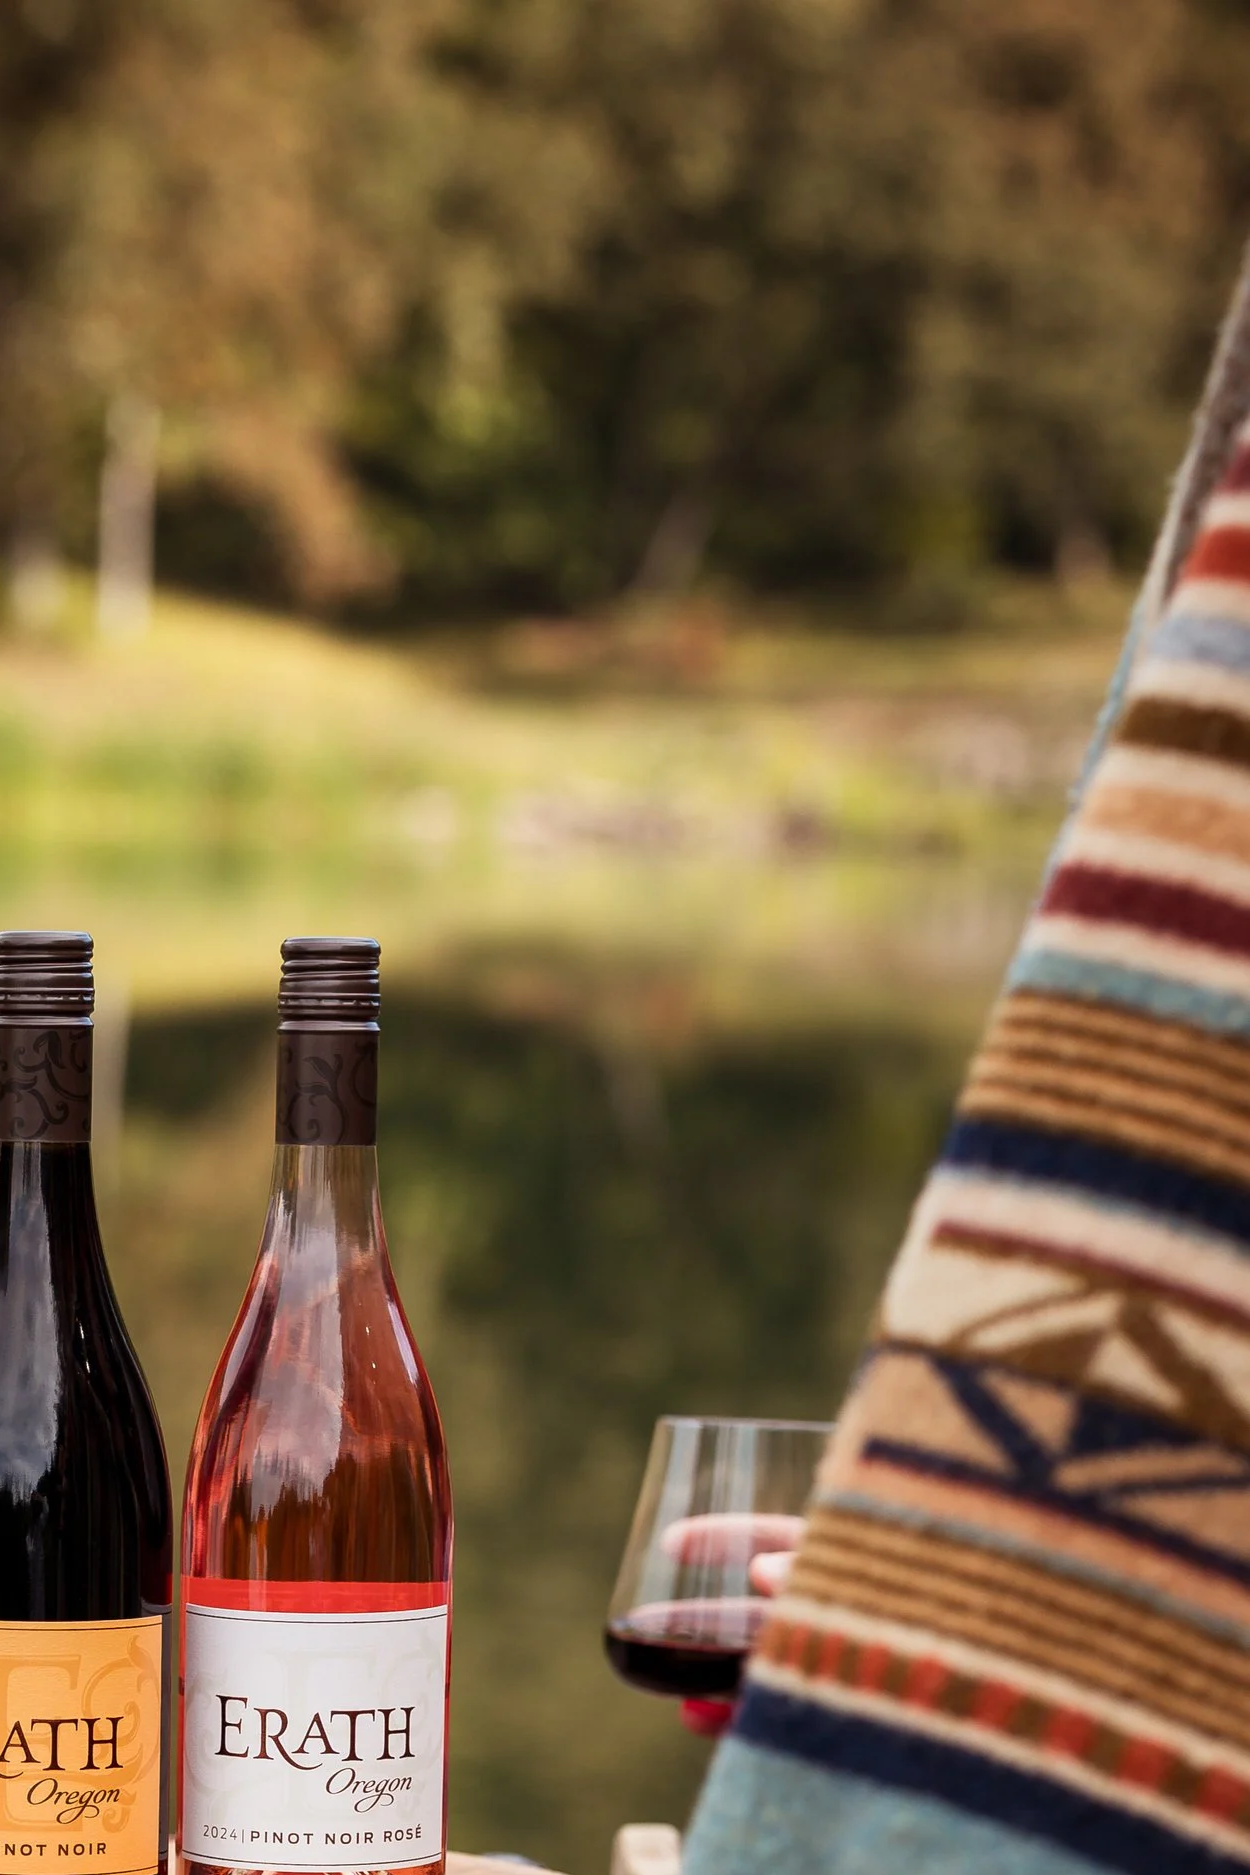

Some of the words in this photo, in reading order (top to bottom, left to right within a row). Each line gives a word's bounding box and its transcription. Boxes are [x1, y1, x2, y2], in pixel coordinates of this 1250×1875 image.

[214, 1694, 416, 1771] ERATH
[26, 1778, 120, 1824] Oregon
[325, 1767, 413, 1813] Oregon
[57, 1842, 107, 1857] NOIR
[203, 1824, 238, 1841] 2024
[250, 1830, 314, 1845] PINOT
[324, 1831, 375, 1845] NOIR
[383, 1823, 422, 1843] ROSÉ
